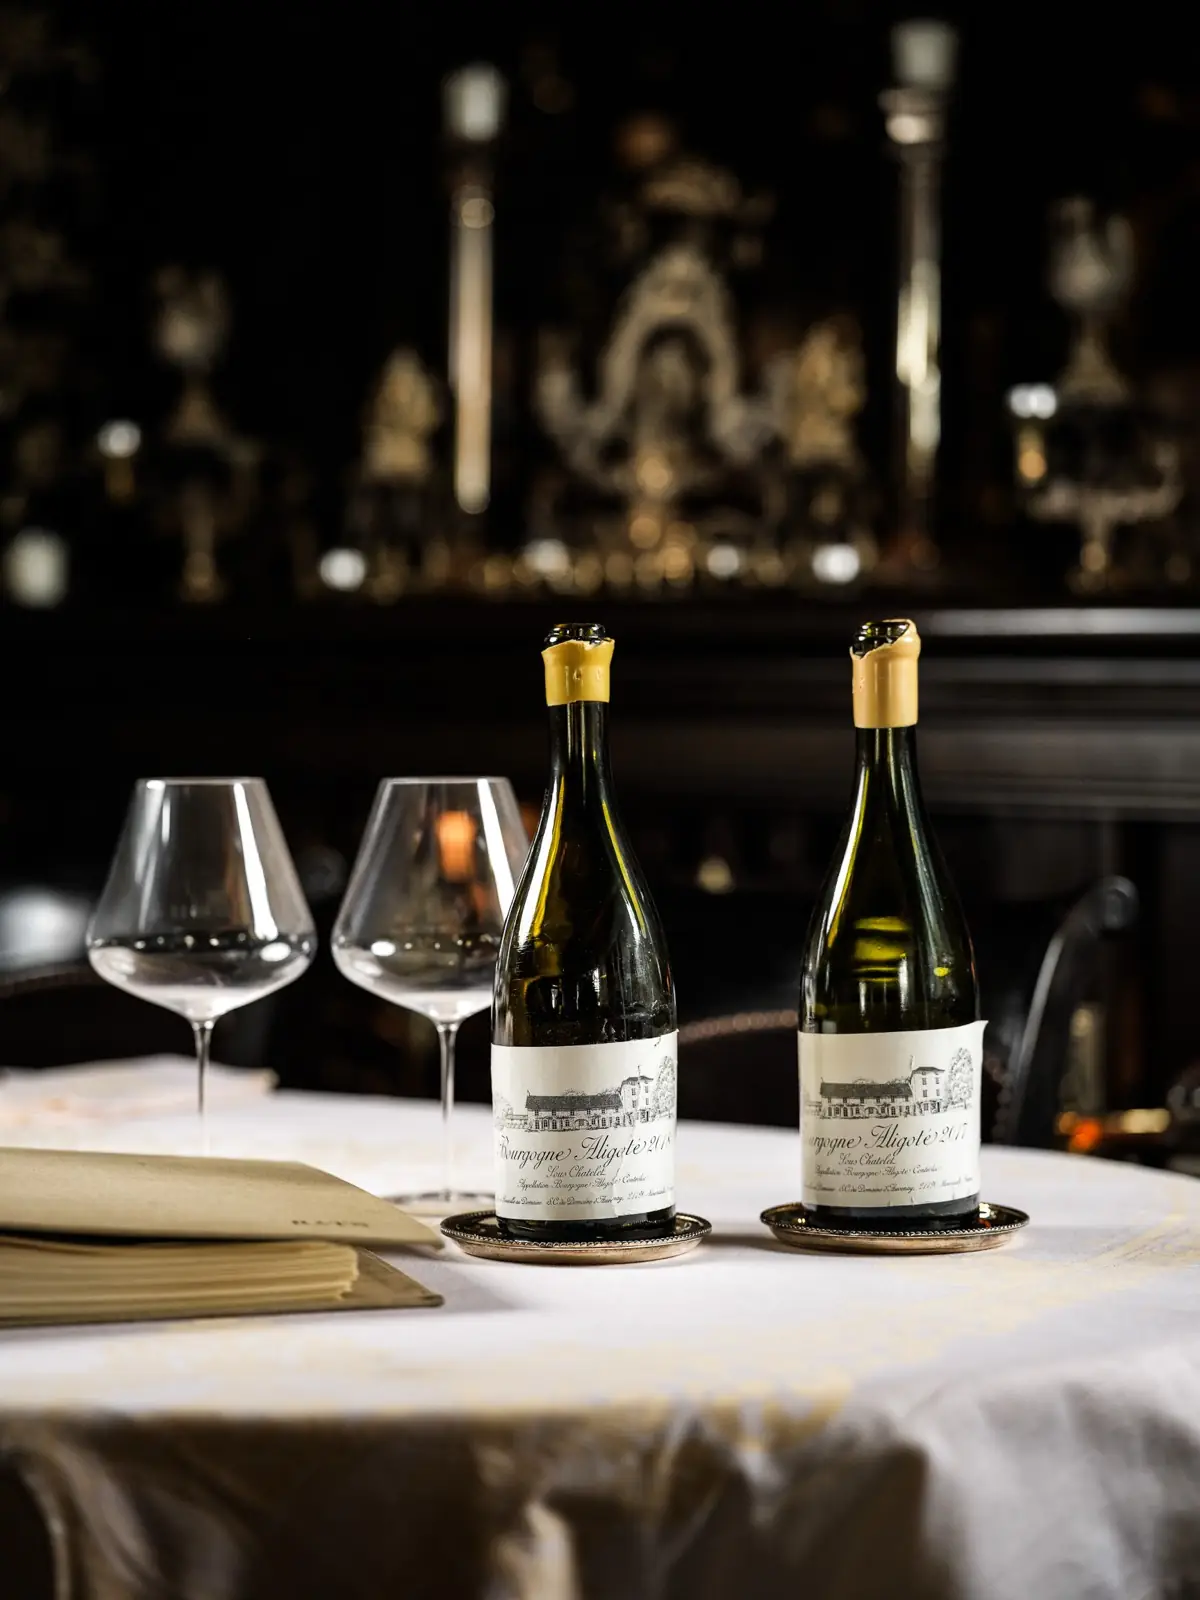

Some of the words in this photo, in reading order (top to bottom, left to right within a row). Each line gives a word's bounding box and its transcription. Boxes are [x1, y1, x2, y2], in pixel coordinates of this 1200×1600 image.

[499, 1134, 572, 1170] Bourgogne
[574, 1134, 647, 1168] Aligoté
[809, 1136, 862, 1157] urgogne
[864, 1123, 938, 1157] Aligoté
[837, 1152, 858, 1166] Sous
[546, 1165, 567, 1178] Sous
